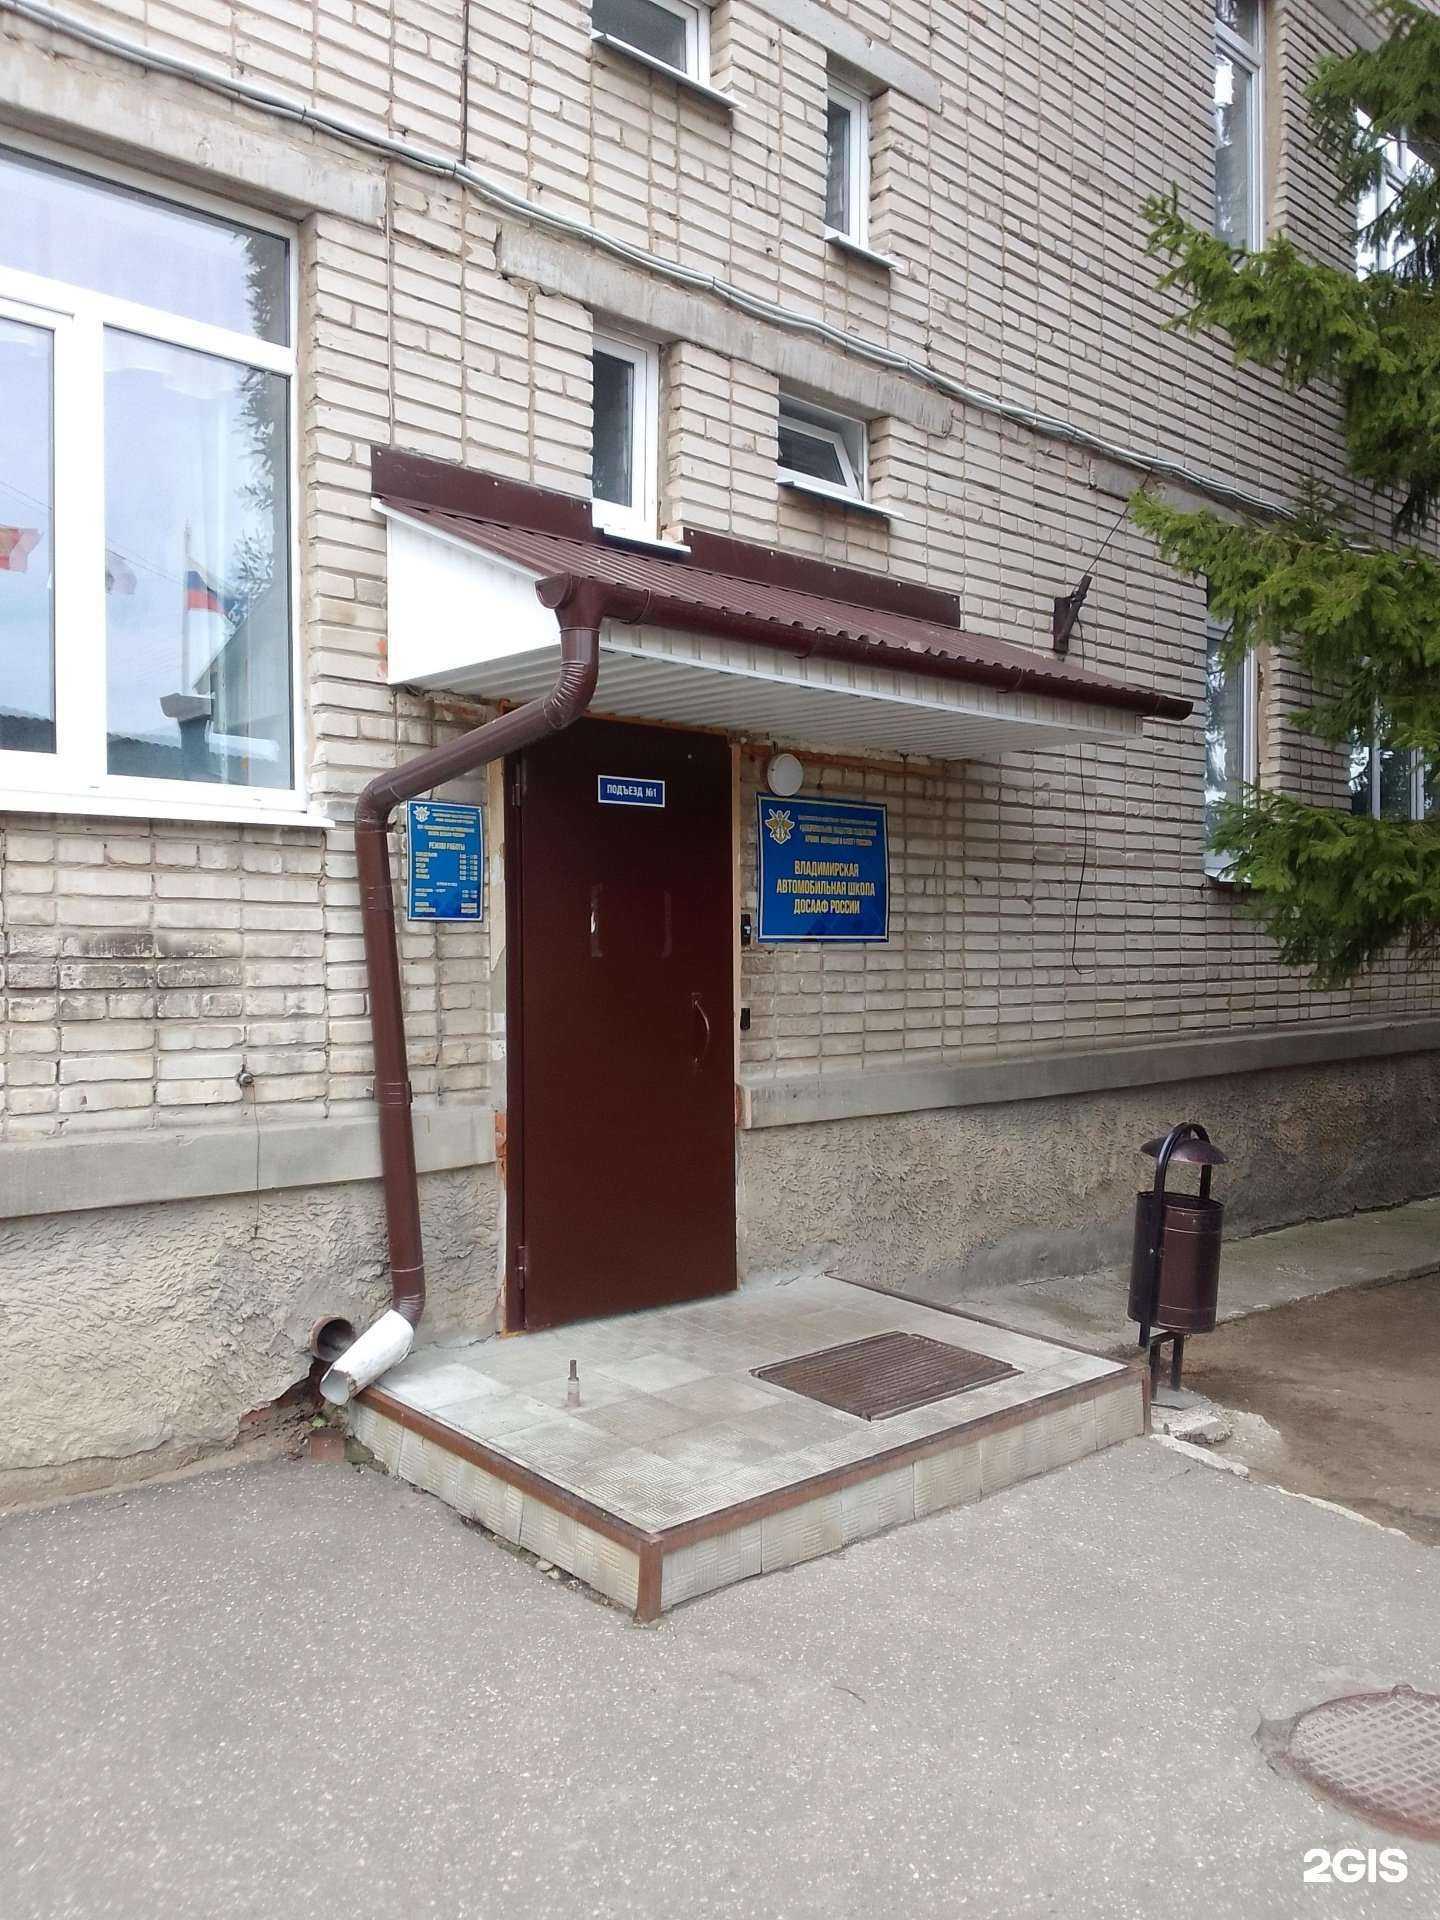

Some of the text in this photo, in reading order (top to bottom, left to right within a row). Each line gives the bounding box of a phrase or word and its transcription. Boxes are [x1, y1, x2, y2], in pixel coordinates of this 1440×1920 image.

[606, 784, 657, 798] ПОДЪЕЗД №1
[794, 860, 859, 877] ВЛАДИМИРСКАЯ
[776, 879, 875, 896] АВТОМОБИЛЬНАЯ ШКОЛА
[793, 899, 860, 914] ДОСААФ РОССИИ
